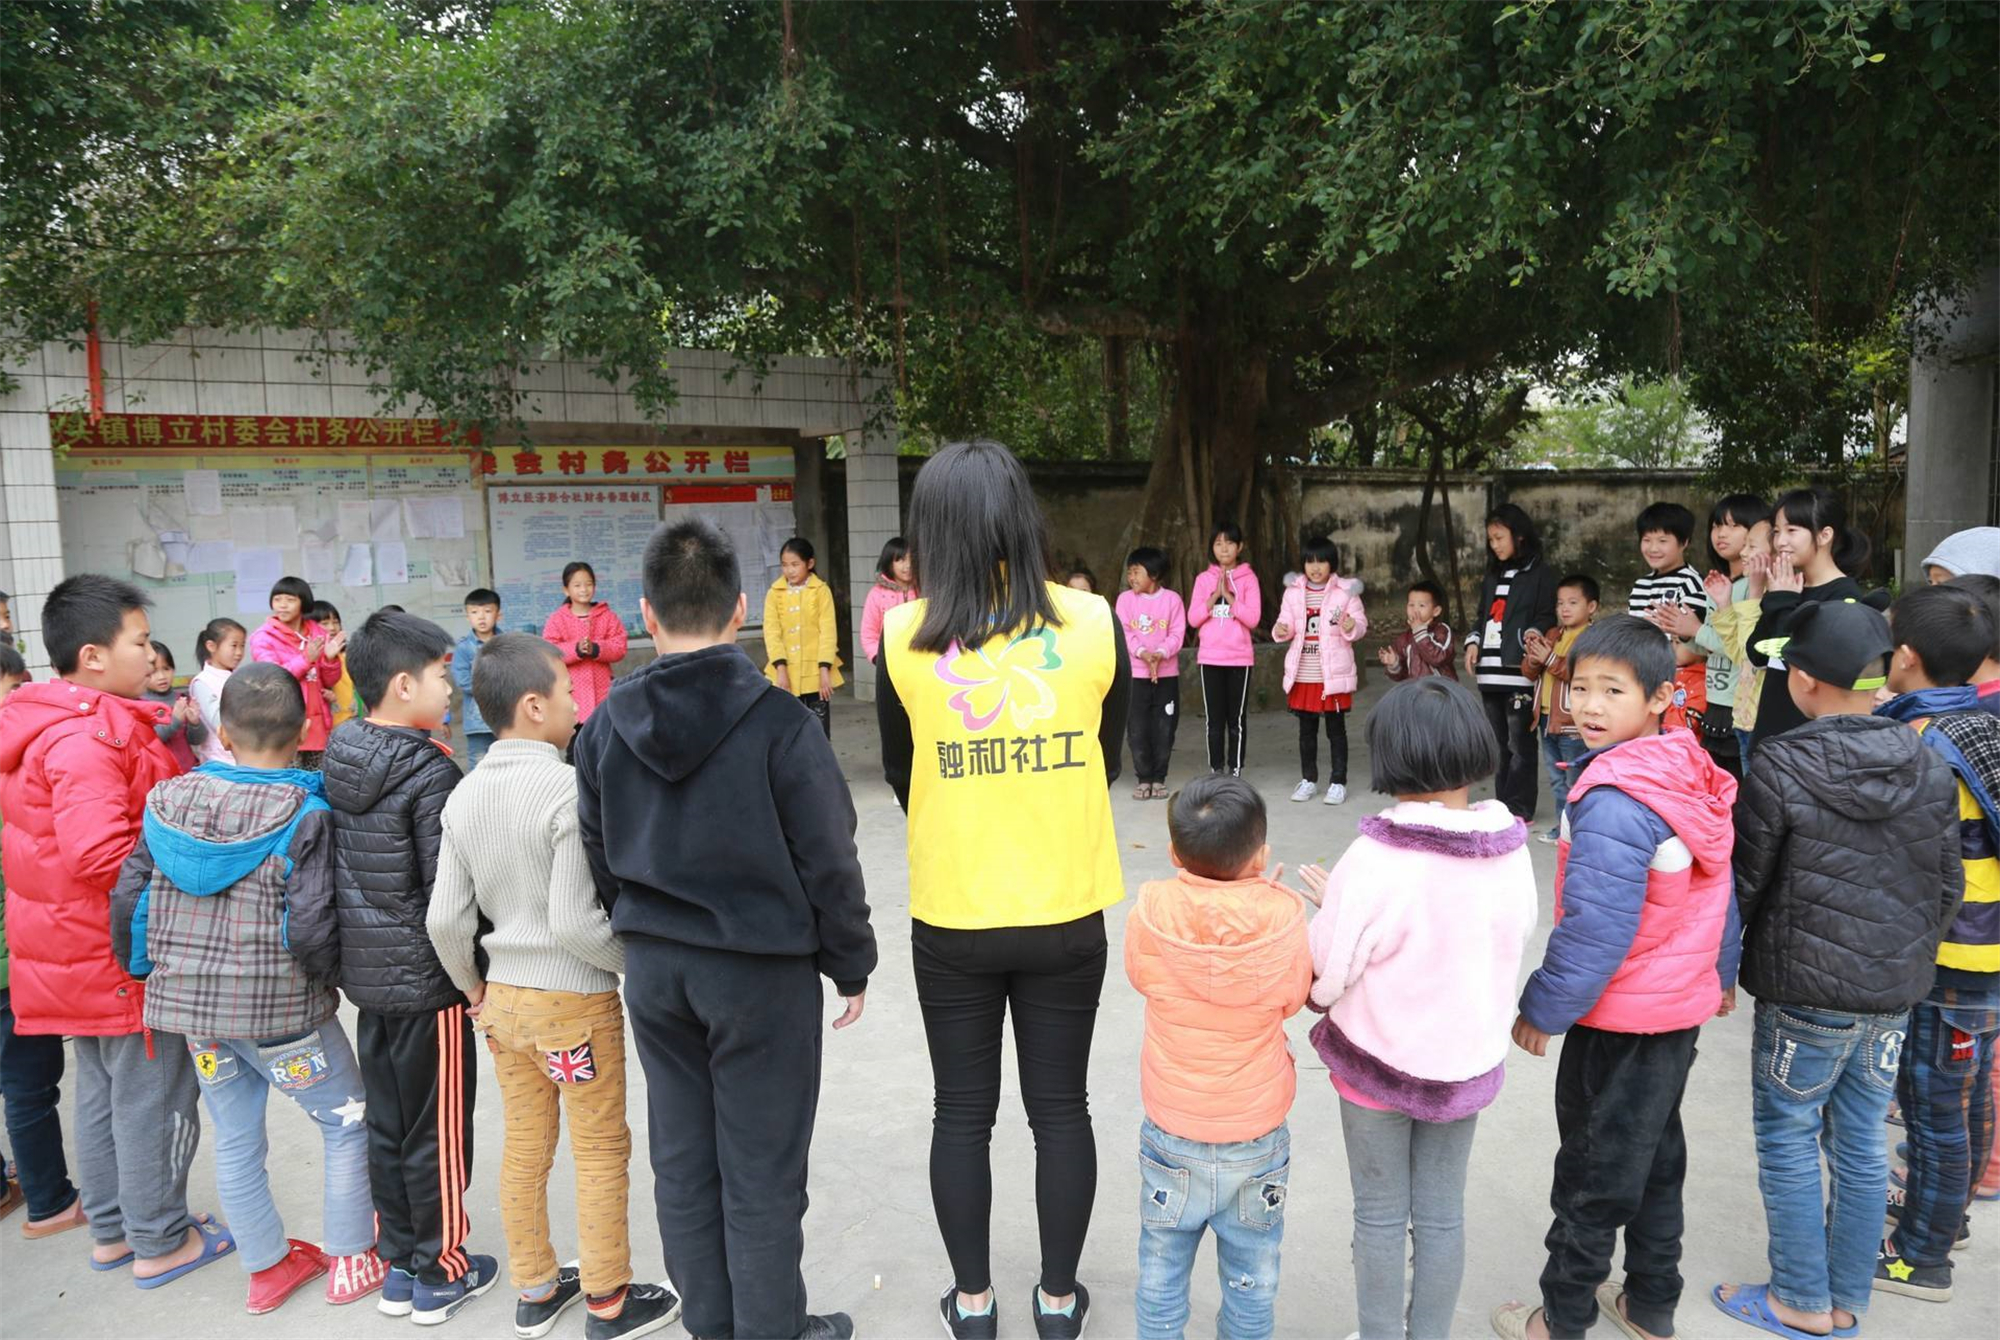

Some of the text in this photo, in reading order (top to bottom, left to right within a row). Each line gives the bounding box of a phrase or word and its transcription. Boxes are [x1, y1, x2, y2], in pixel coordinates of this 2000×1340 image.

[51, 415, 436, 445] 头镇博立村委会村务公开栏
[936, 730, 1086, 779] 融和社工
